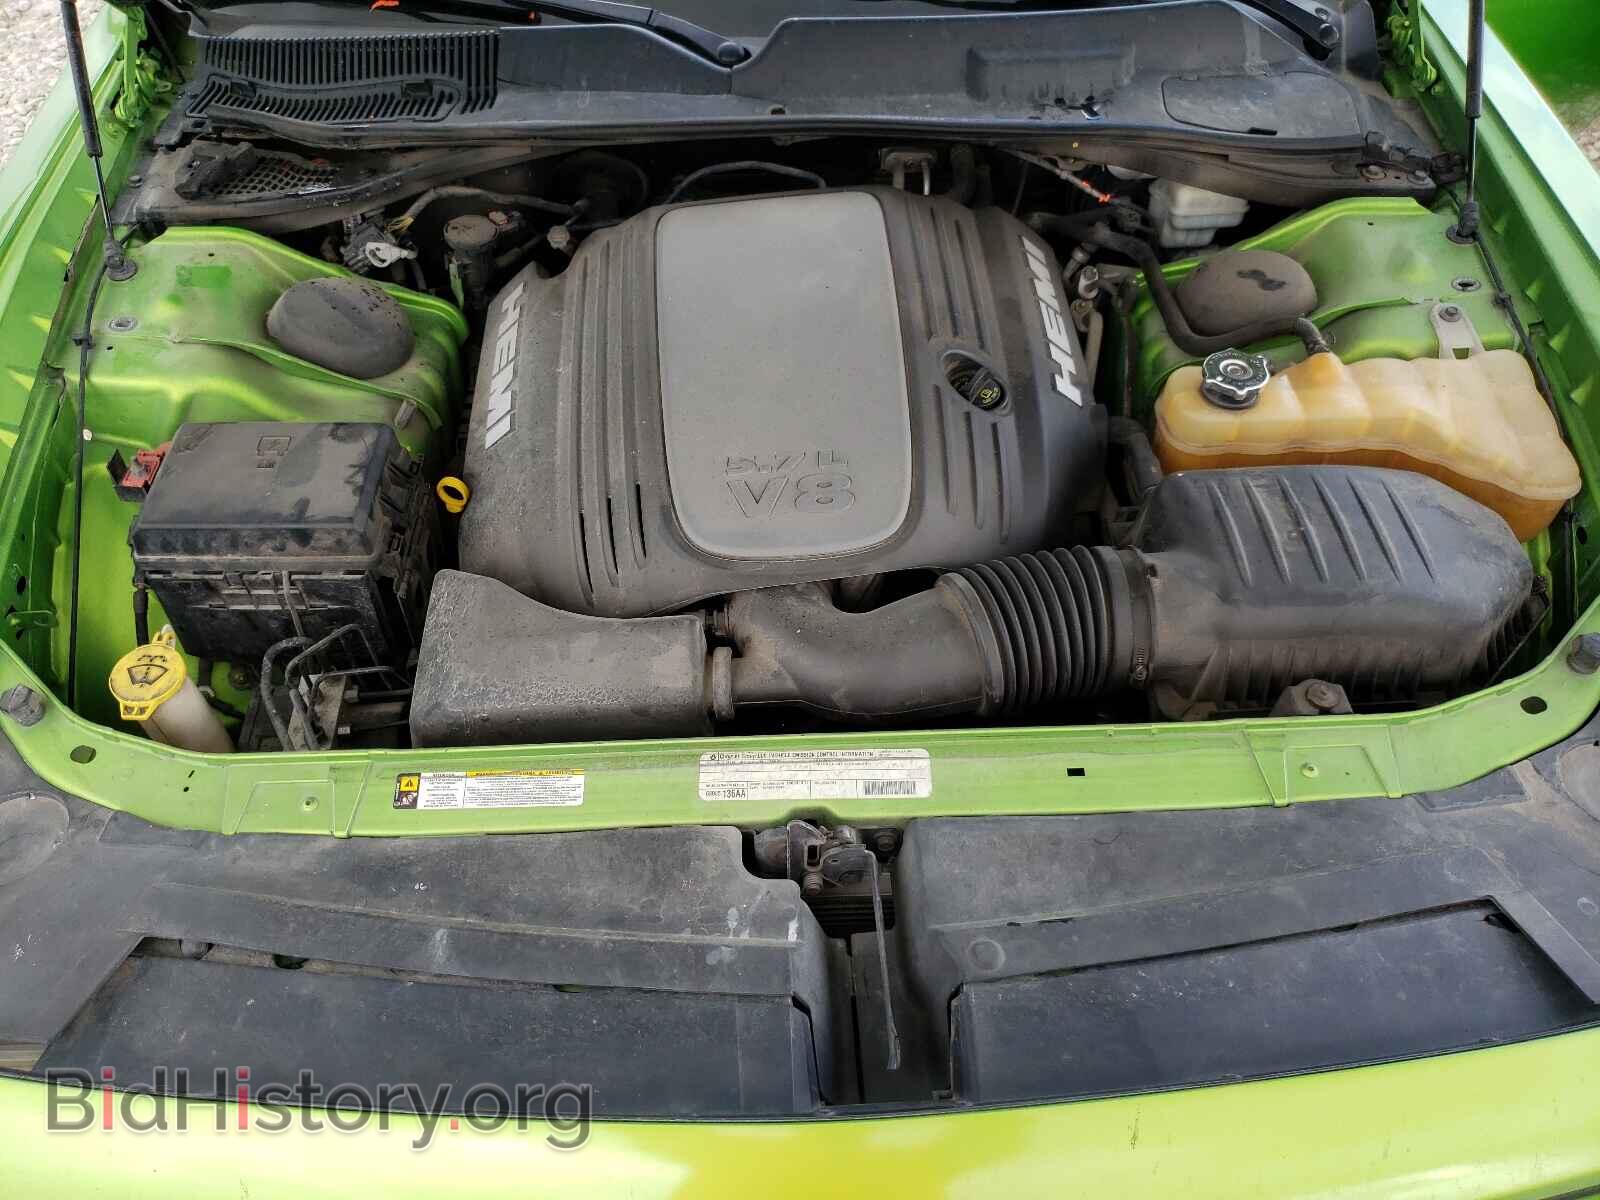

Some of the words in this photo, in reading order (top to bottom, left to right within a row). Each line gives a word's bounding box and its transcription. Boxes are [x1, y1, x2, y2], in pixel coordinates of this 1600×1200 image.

[484, 282, 524, 450] HEMI
[1022, 235, 1083, 407] HEMI
[725, 450, 849, 475] 5.7L
[726, 473, 856, 518] V8
